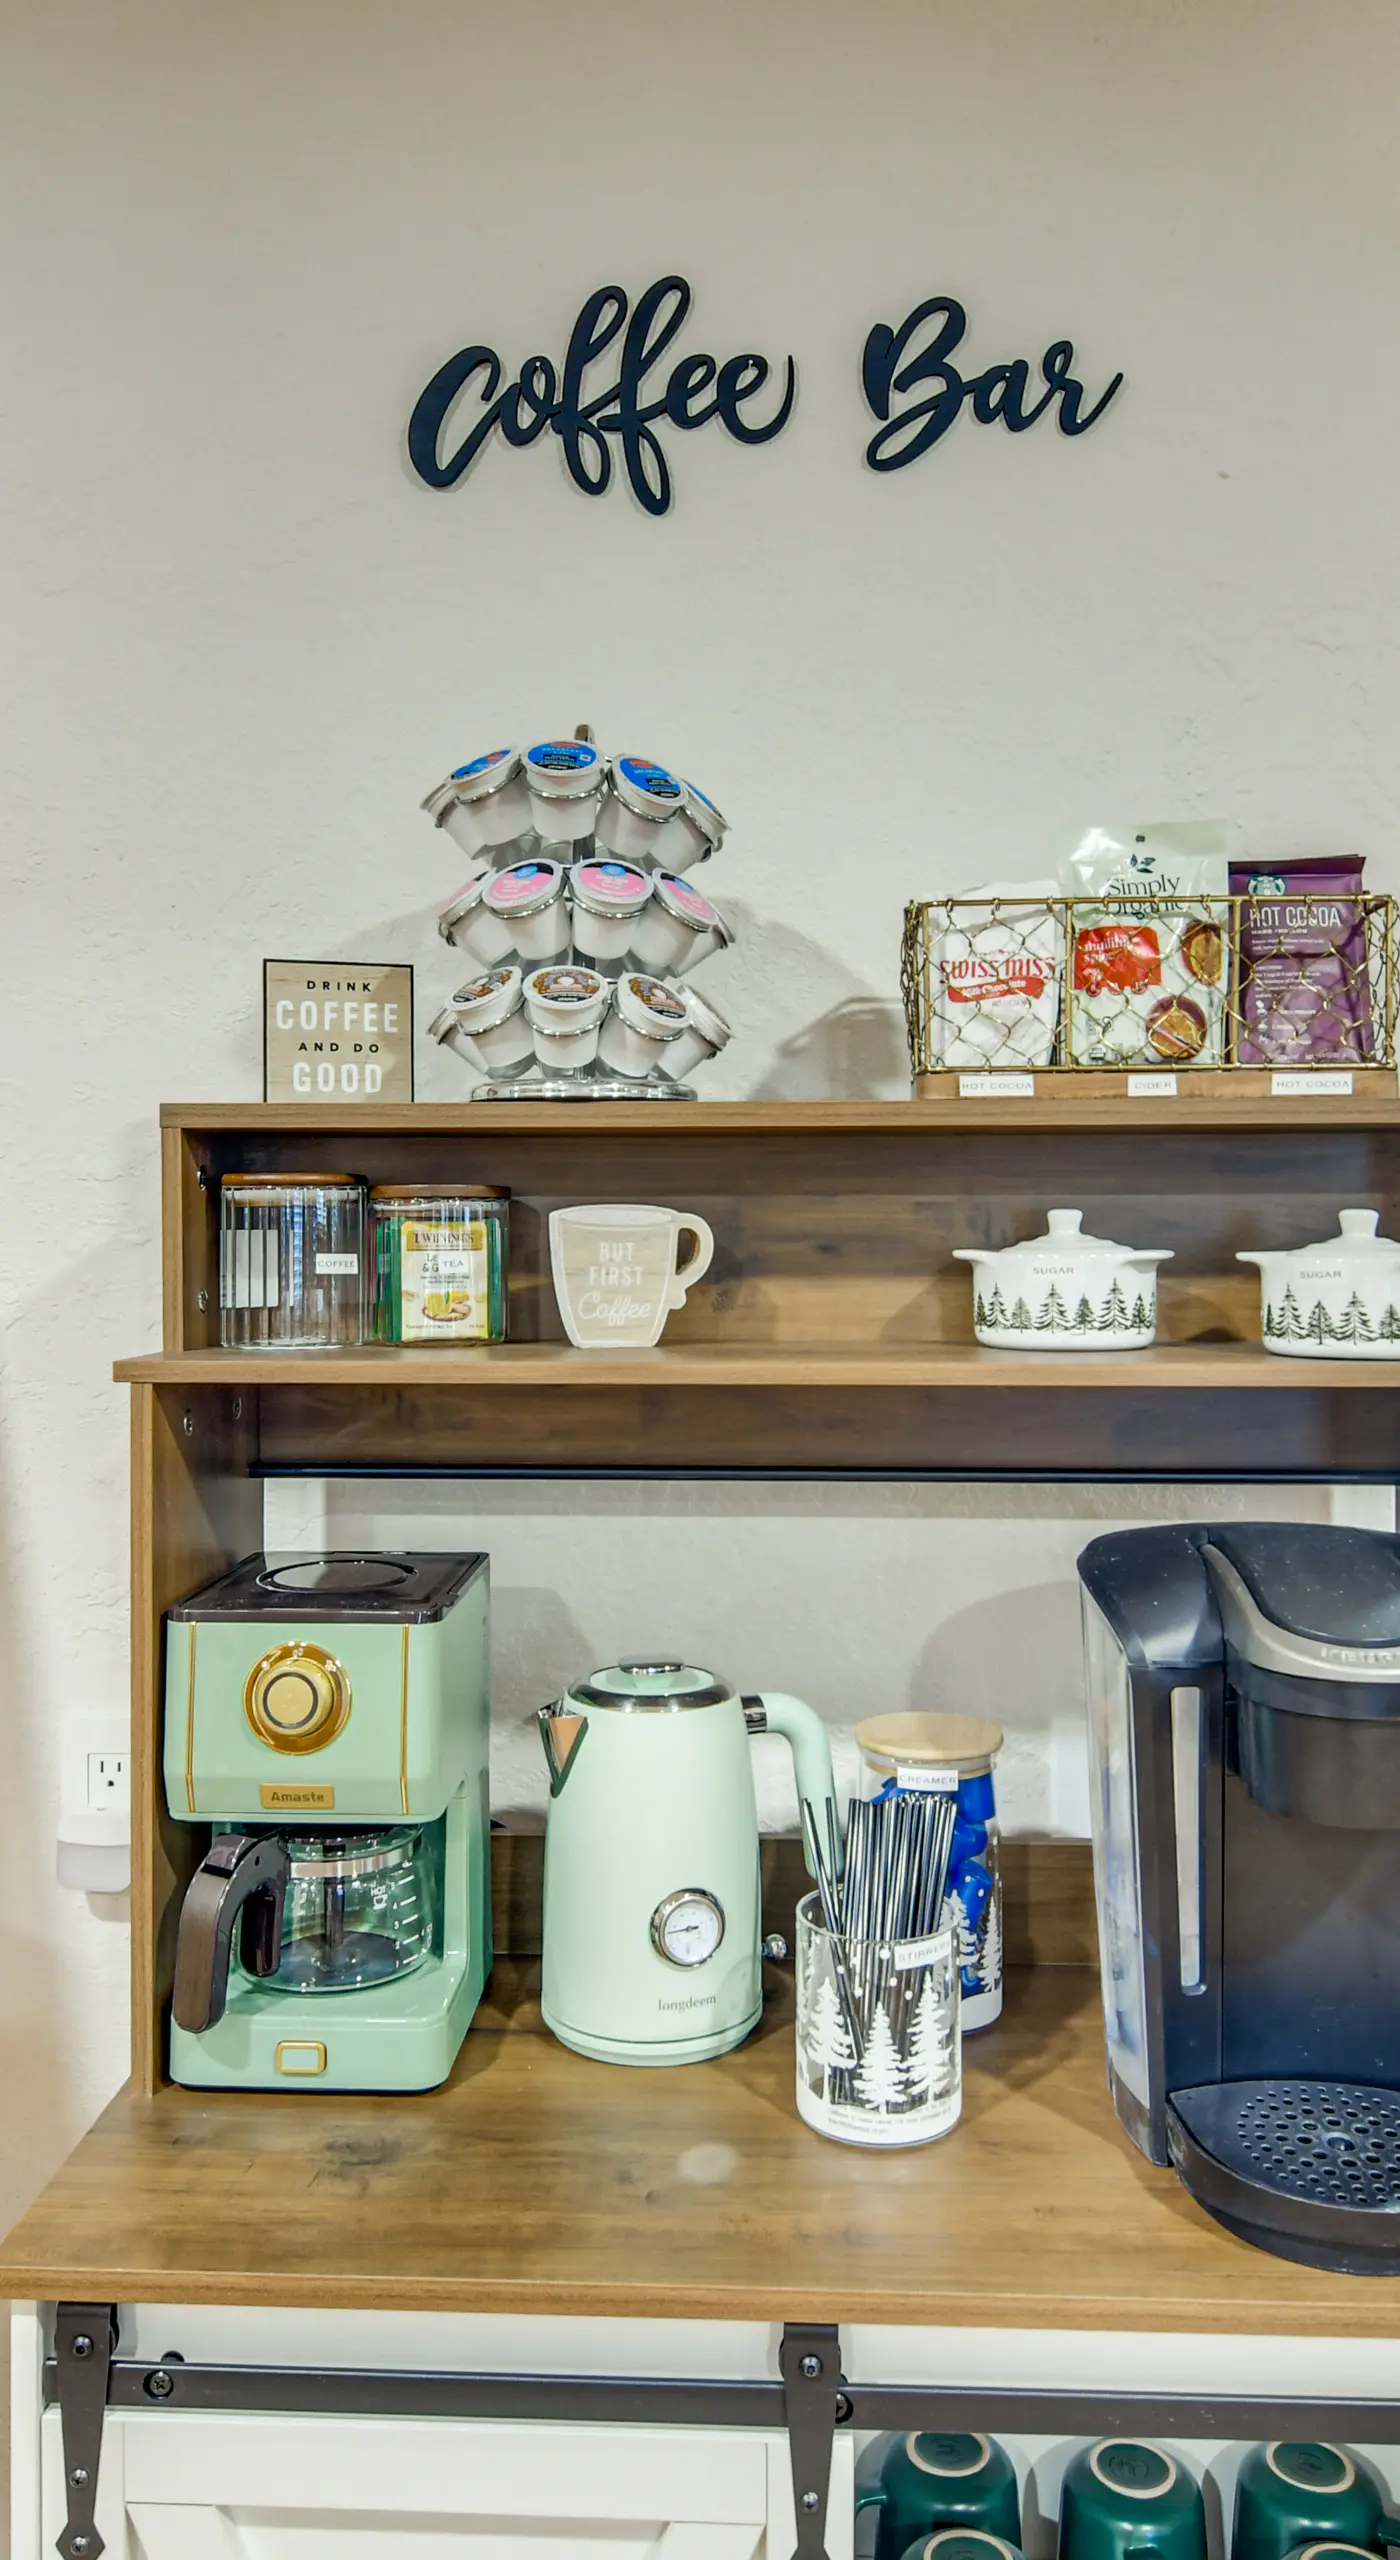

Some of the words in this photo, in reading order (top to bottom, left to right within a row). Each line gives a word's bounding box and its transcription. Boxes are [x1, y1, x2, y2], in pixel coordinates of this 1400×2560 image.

[863, 296, 1124, 471] Bar
[1107, 873, 1181, 899] Simply
[1249, 906, 1281, 927] HOT
[1285, 906, 1342, 927] COCOA
[306, 980, 371, 992] DRINK
[276, 1000, 398, 1033] COFFEE
[298, 1042, 339, 1052] AND
[353, 1043, 379, 1053] DO
[292, 1062, 382, 1093] GOOD
[962, 1082, 986, 1090] HOT
[989, 1082, 1033, 1090] COCOA
[1134, 1081, 1172, 1090] CIDER
[1276, 1080, 1301, 1089] HOT
[1305, 1080, 1349, 1089] COCOA
[599, 1241, 635, 1262] BUT
[317, 1259, 355, 1268] COFFEE
[443, 1260, 464, 1268] TEA
[589, 1265, 644, 1287] FIRST
[1033, 1266, 1074, 1275] SUGAR
[1299, 1270, 1342, 1279] SUGAR
[578, 1290, 651, 1327] Coffee
[899, 1775, 957, 1785] CREAMER
[271, 1791, 324, 1802] Amaste
[658, 1996, 717, 2013] longdeem
